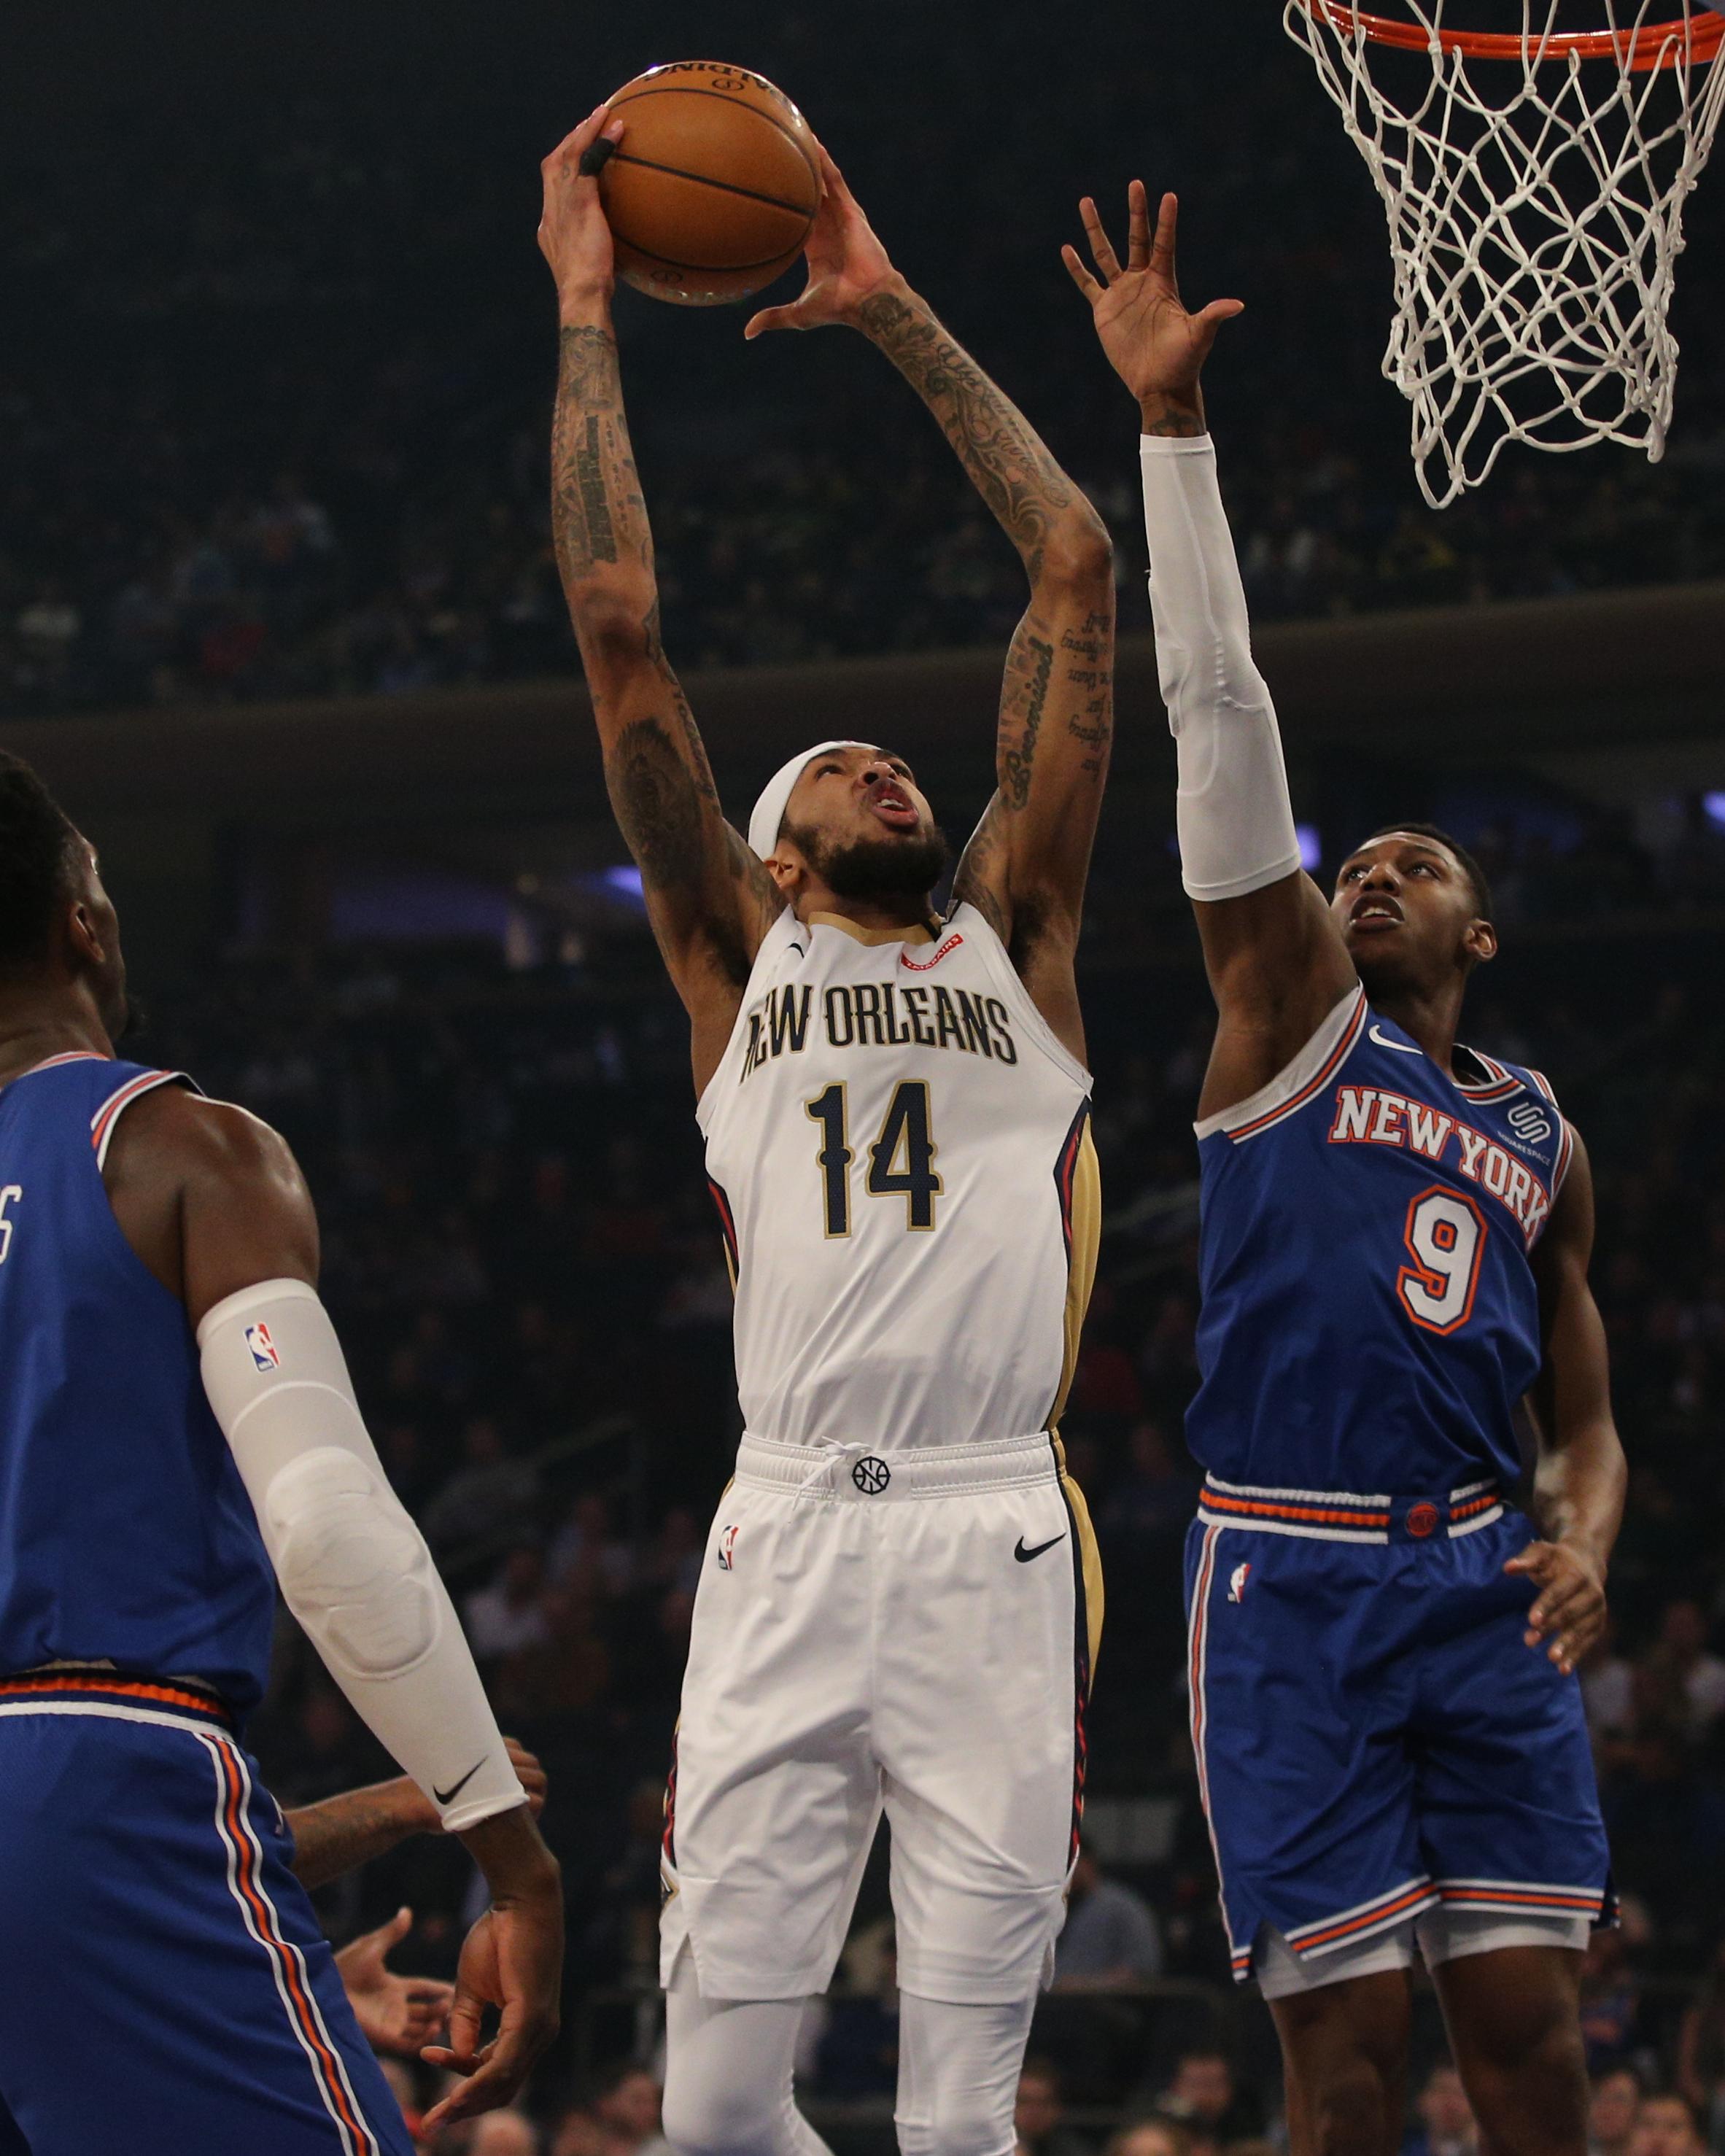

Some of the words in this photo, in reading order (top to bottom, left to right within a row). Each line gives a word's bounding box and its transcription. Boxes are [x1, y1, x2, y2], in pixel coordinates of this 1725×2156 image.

[824, 981, 1019, 1067] ORLEANS
[804, 1079, 945, 1240] 14
[1327, 1085, 1453, 1161] NEW
[1454, 1119, 1551, 1238] YORK
[1396, 1184, 1489, 1336] 9
